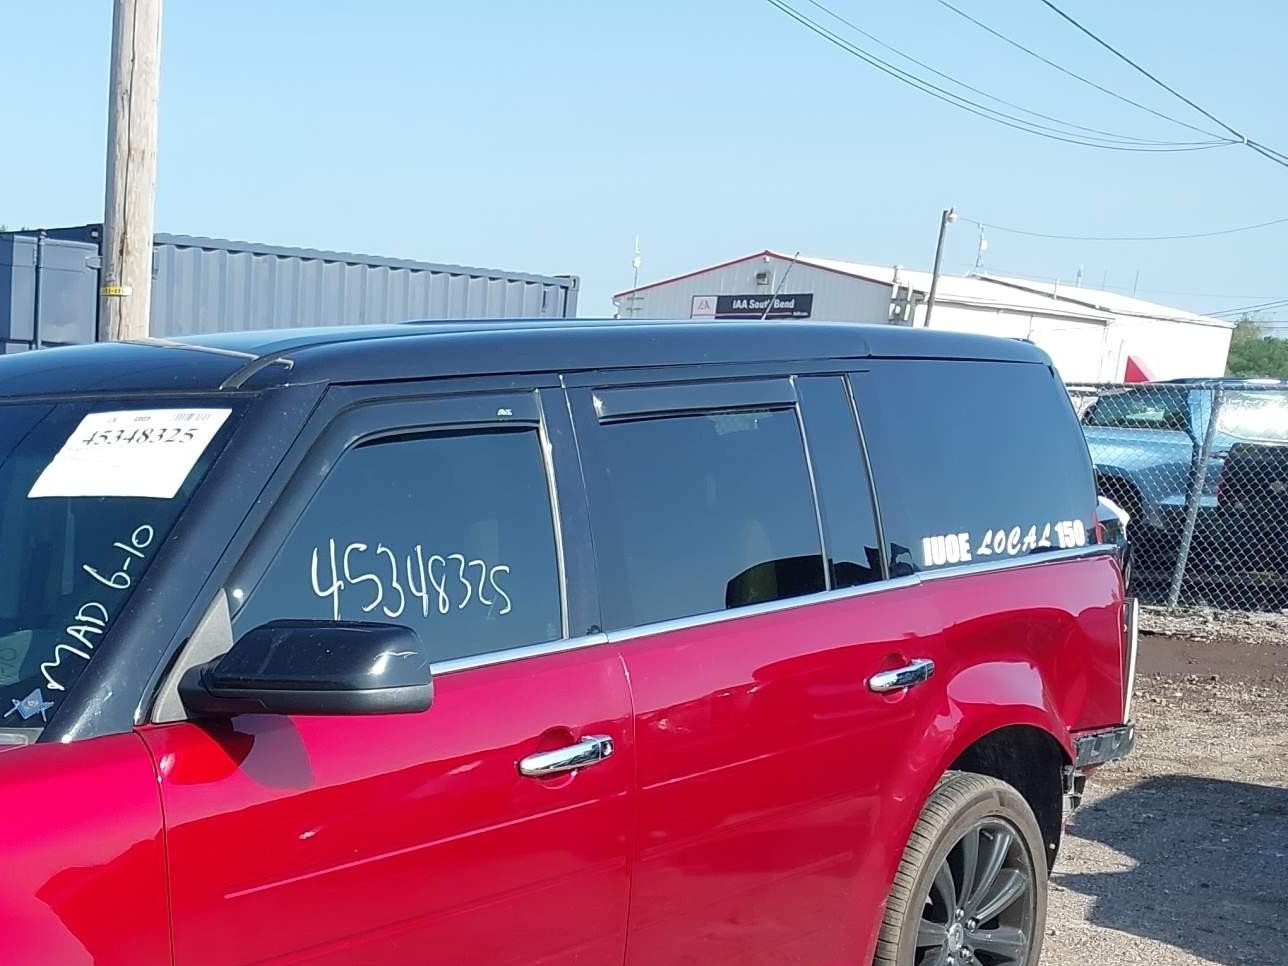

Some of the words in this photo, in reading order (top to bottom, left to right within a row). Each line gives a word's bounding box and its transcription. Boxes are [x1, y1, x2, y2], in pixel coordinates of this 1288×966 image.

[774, 298, 795, 308] Bend
[82, 427, 200, 446] 45348325
[922, 532, 972, 567] IUOE
[976, 523, 1051, 556] LOCAL
[1054, 519, 1085, 549] 150
[312, 538, 512, 622] 45348325
[41, 602, 109, 691] MAD
[83, 525, 154, 589] 6-10
